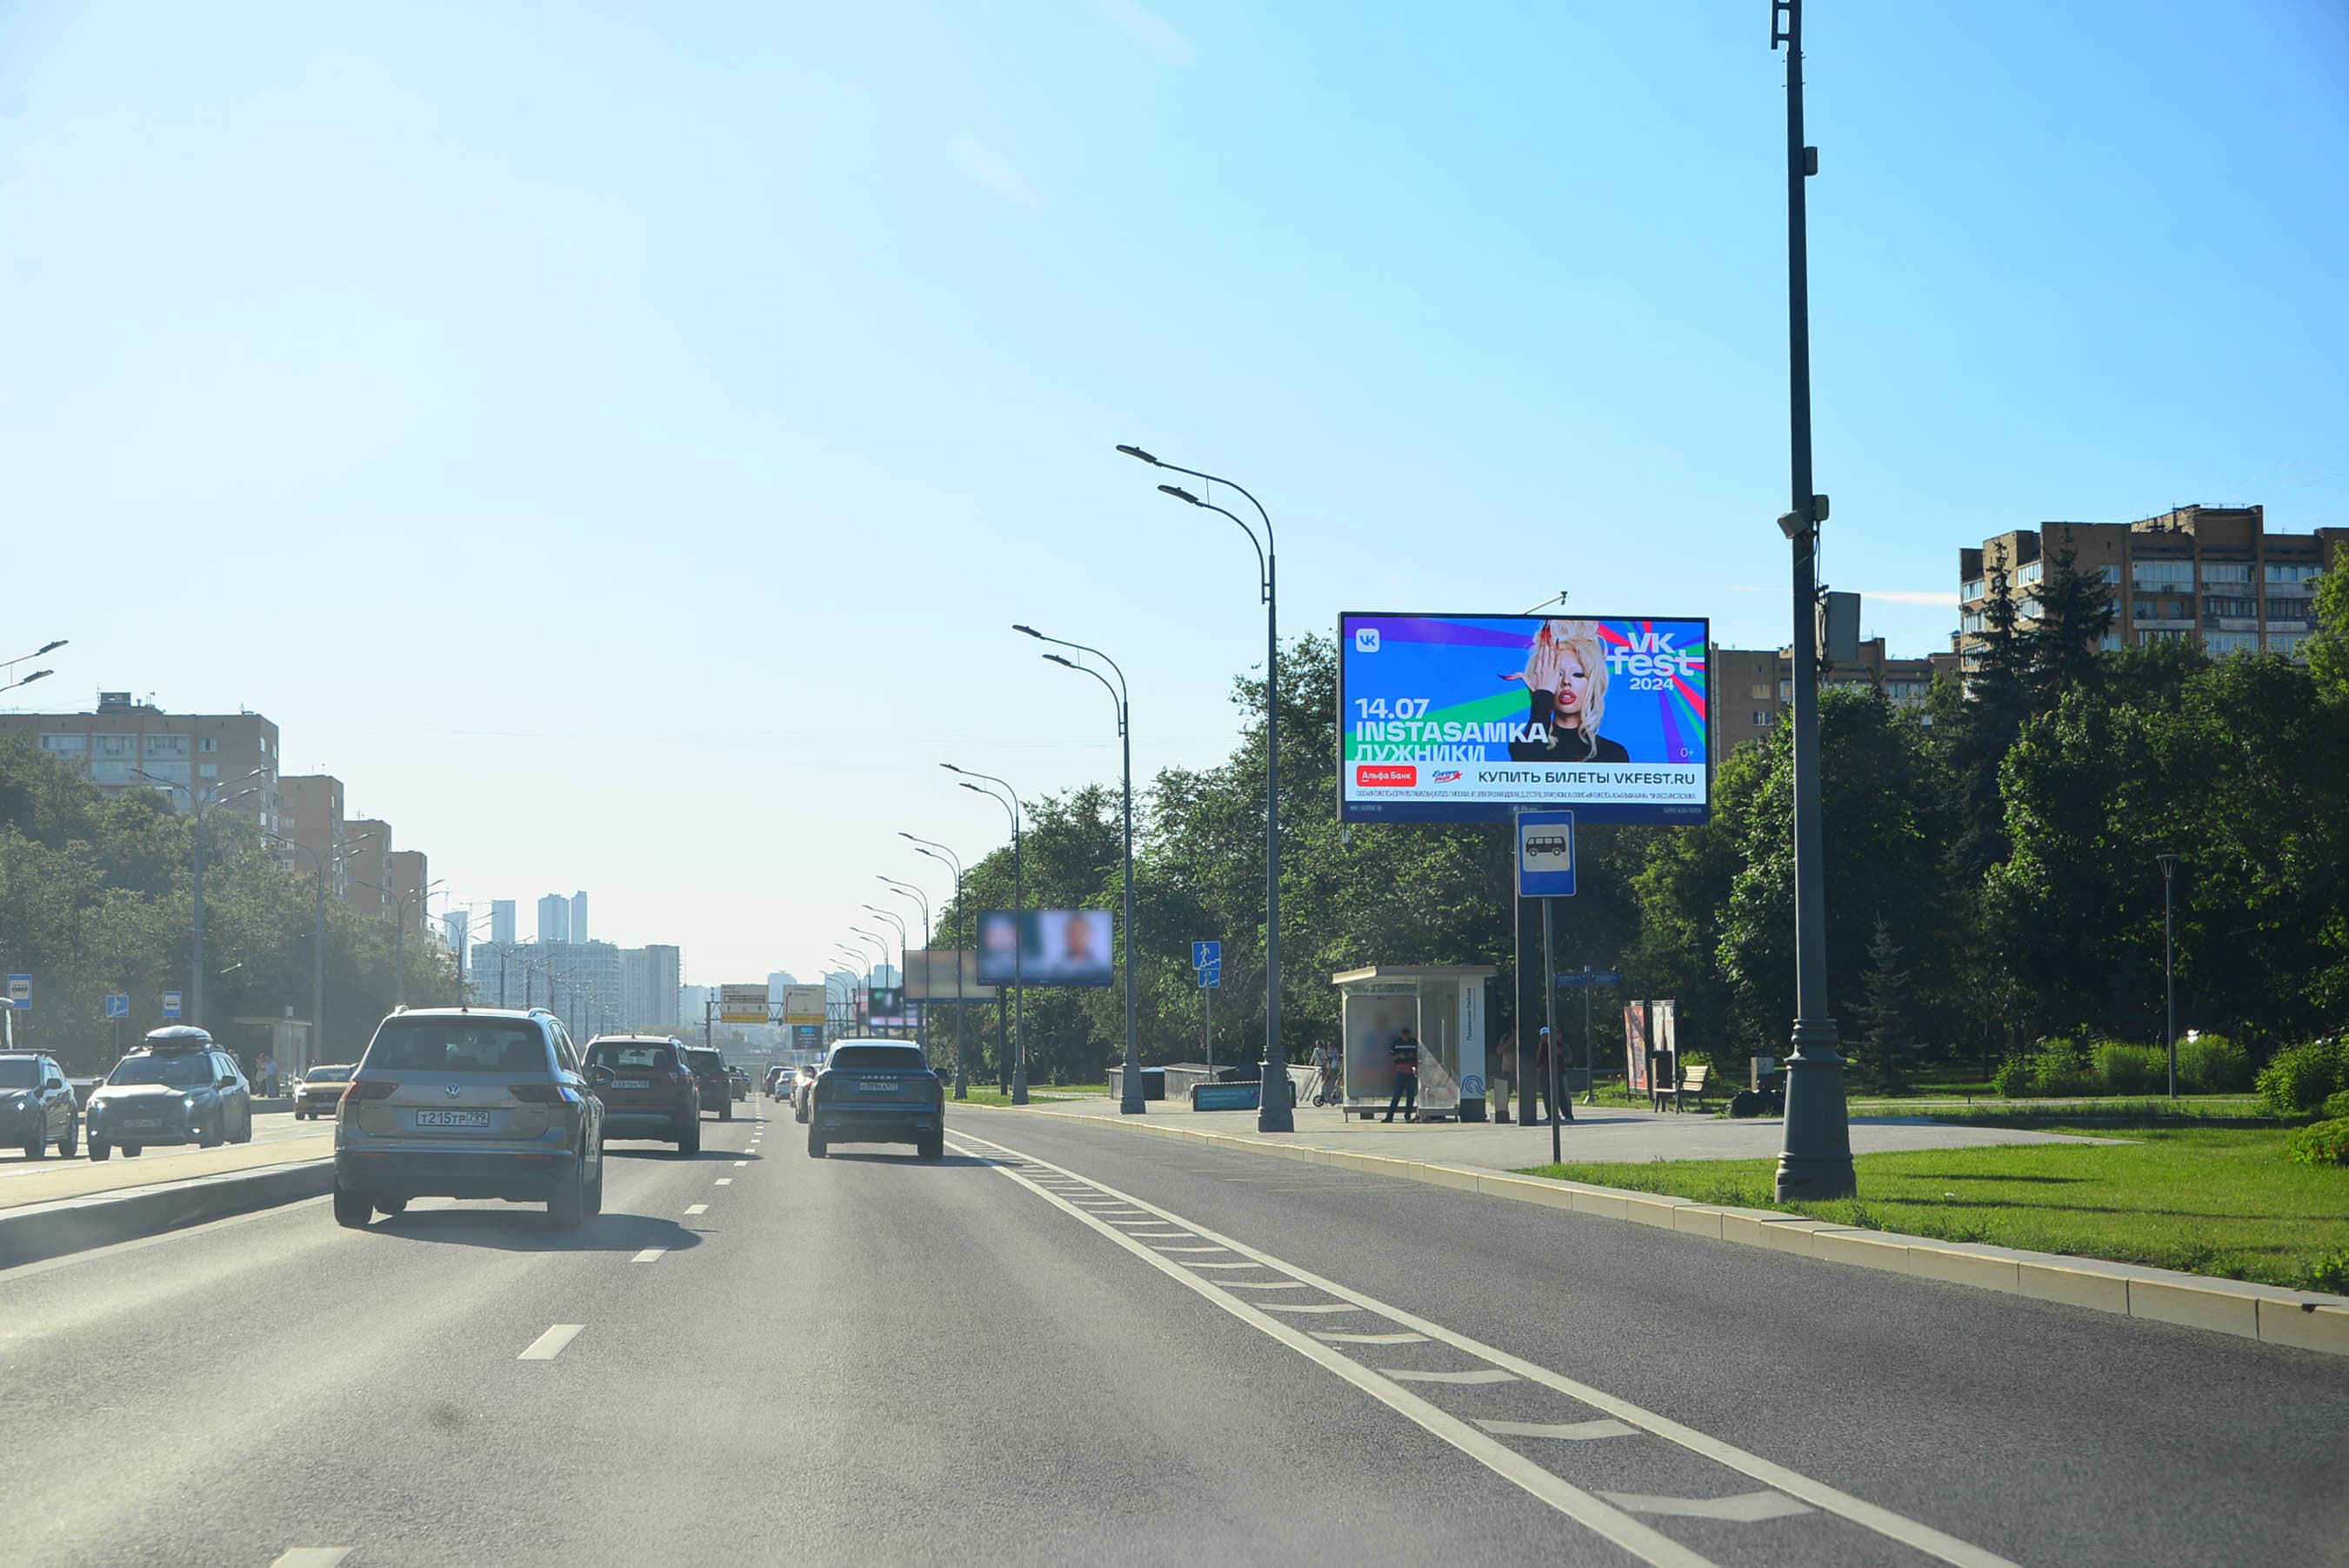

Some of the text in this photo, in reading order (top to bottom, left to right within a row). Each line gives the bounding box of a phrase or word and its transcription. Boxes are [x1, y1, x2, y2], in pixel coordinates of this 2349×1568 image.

[1359, 635, 1376, 646] VK
[1627, 632, 1676, 653] VK
[1609, 646, 1702, 677] fest
[1629, 677, 1675, 691] 2024
[1354, 697, 1431, 720] 14.07
[1355, 721, 1549, 744] INSTASAMKA
[1354, 744, 1485, 762] ЛУЖНИКИ
[1679, 747, 1694, 758] 0+
[1361, 771, 1412, 782] Альфа Банк
[1478, 771, 1696, 785] КУПИТЬ БИЛЕТЫ VKFEST.RU
